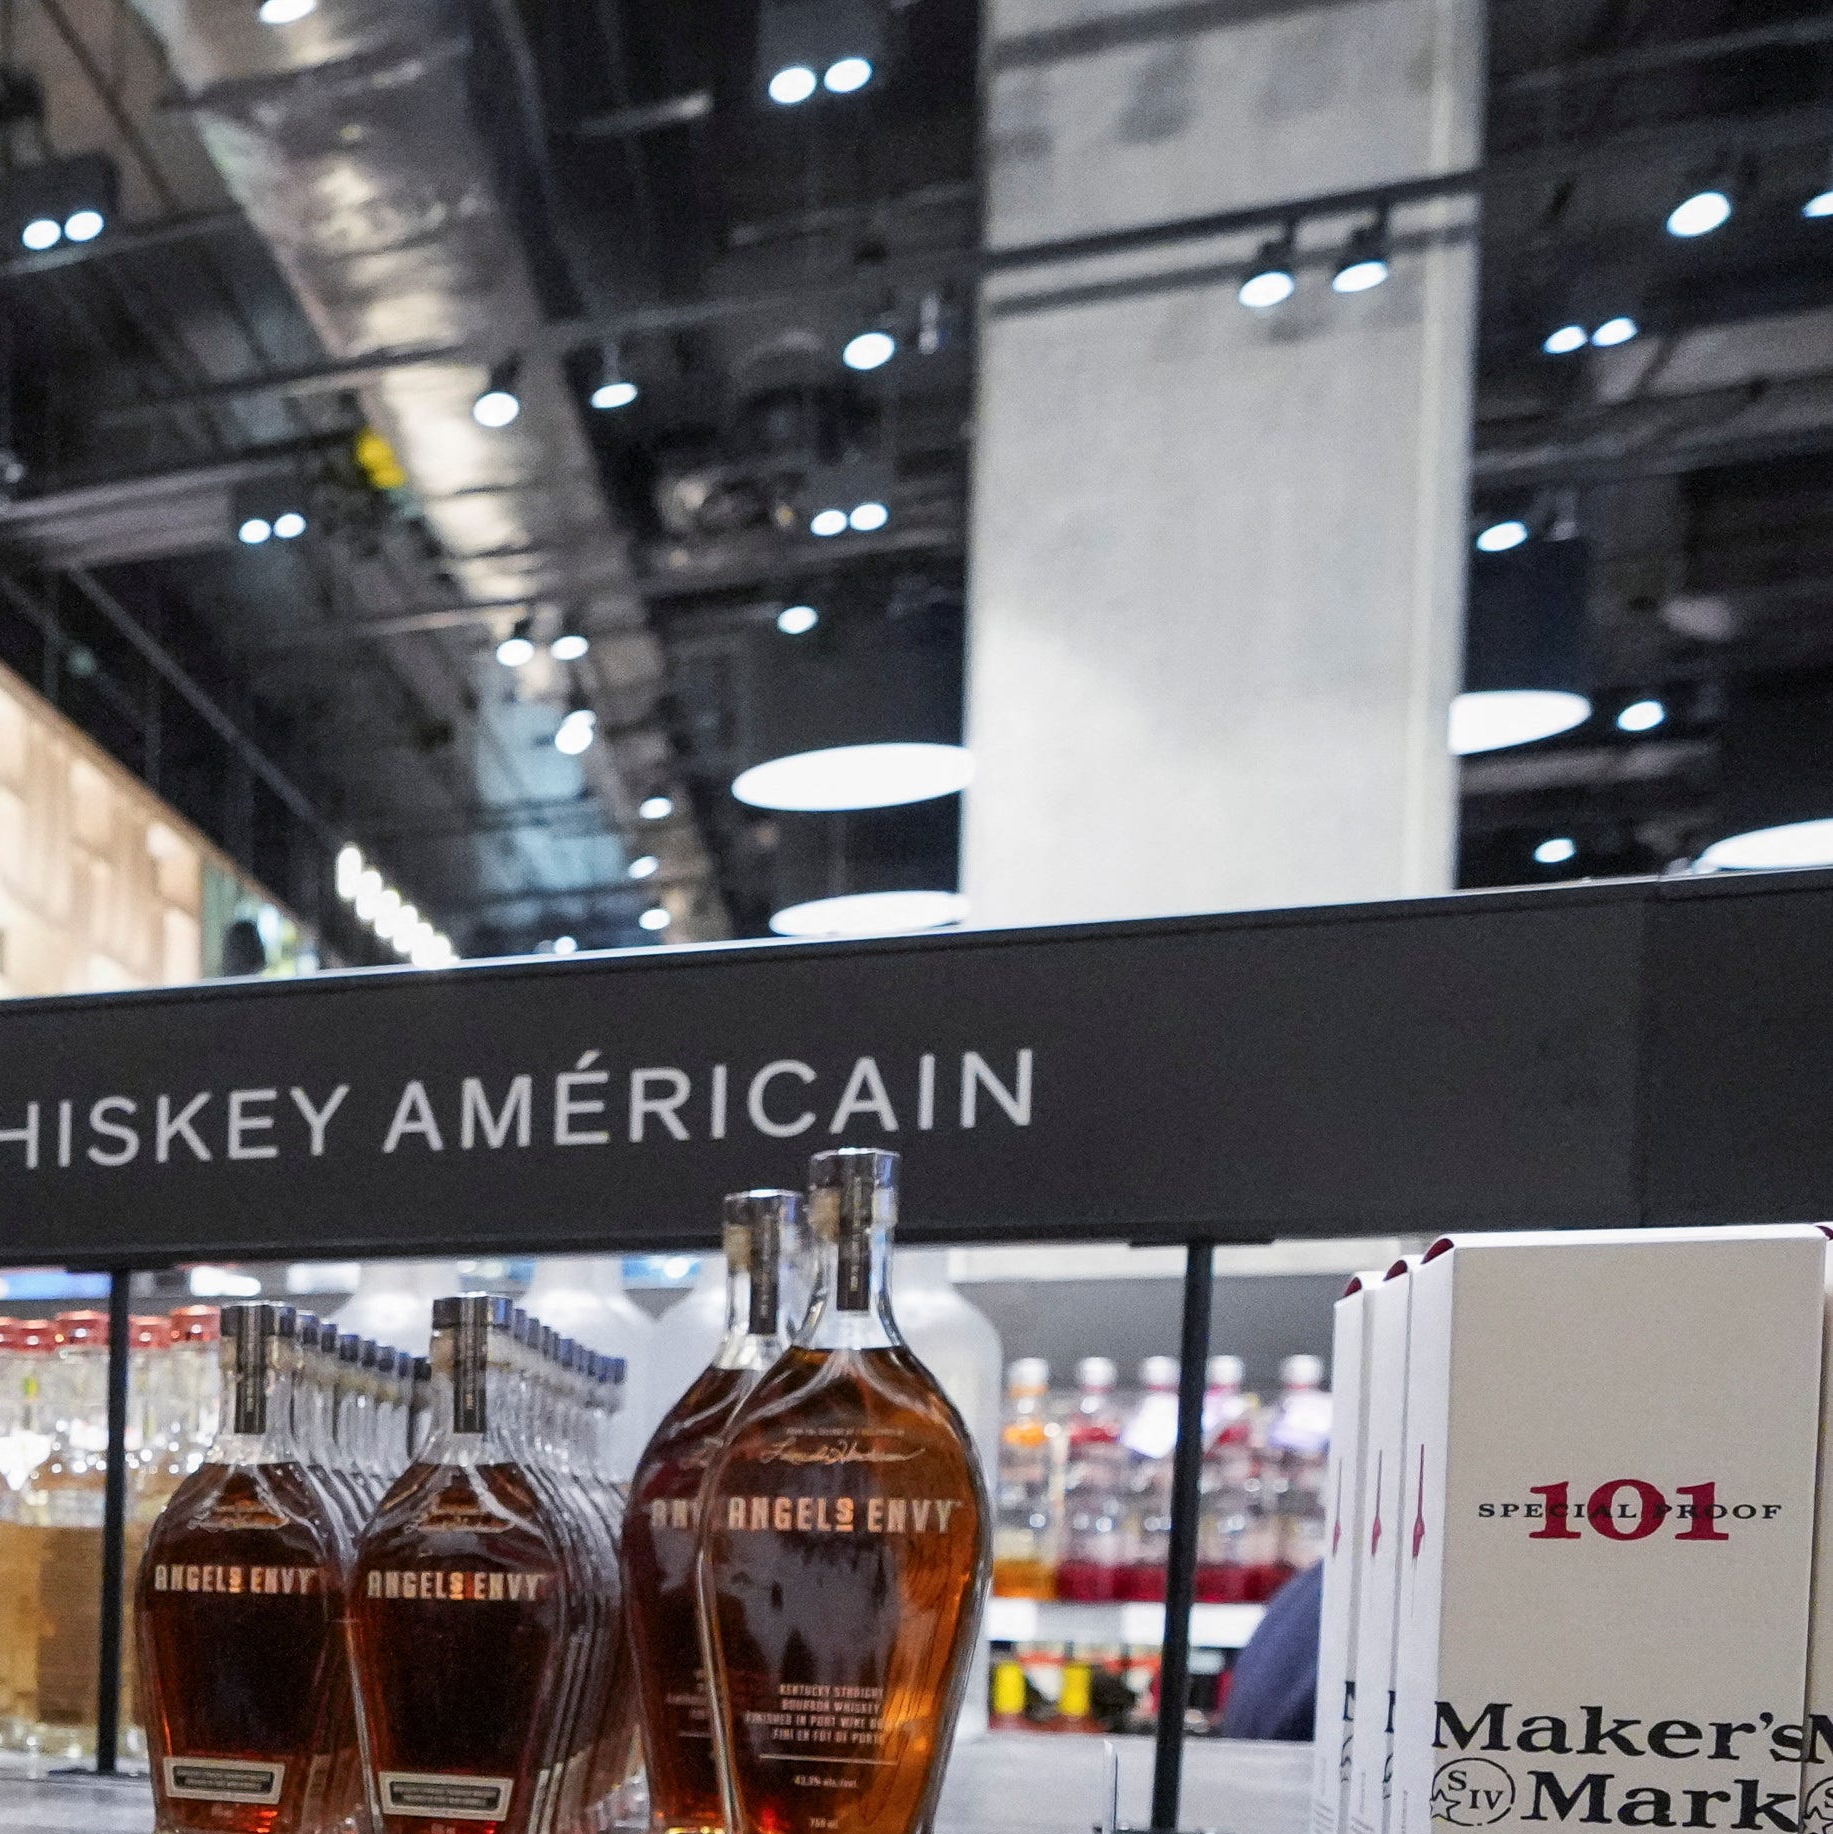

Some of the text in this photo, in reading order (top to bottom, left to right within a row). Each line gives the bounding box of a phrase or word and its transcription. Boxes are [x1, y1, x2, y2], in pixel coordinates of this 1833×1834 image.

[382, 1047, 1034, 1151] AMÉRICAIN
[866, 1497, 954, 1534] ENVY
[1478, 1503, 1783, 1520] SPECIAL PROOF
[1528, 1479, 1729, 1541] 101
[250, 1567, 312, 1595] ENVY
[473, 1571, 538, 1601] ENVY
[1431, 1700, 1804, 1763] Maker's
[1520, 1770, 1800, 1834] Mark
